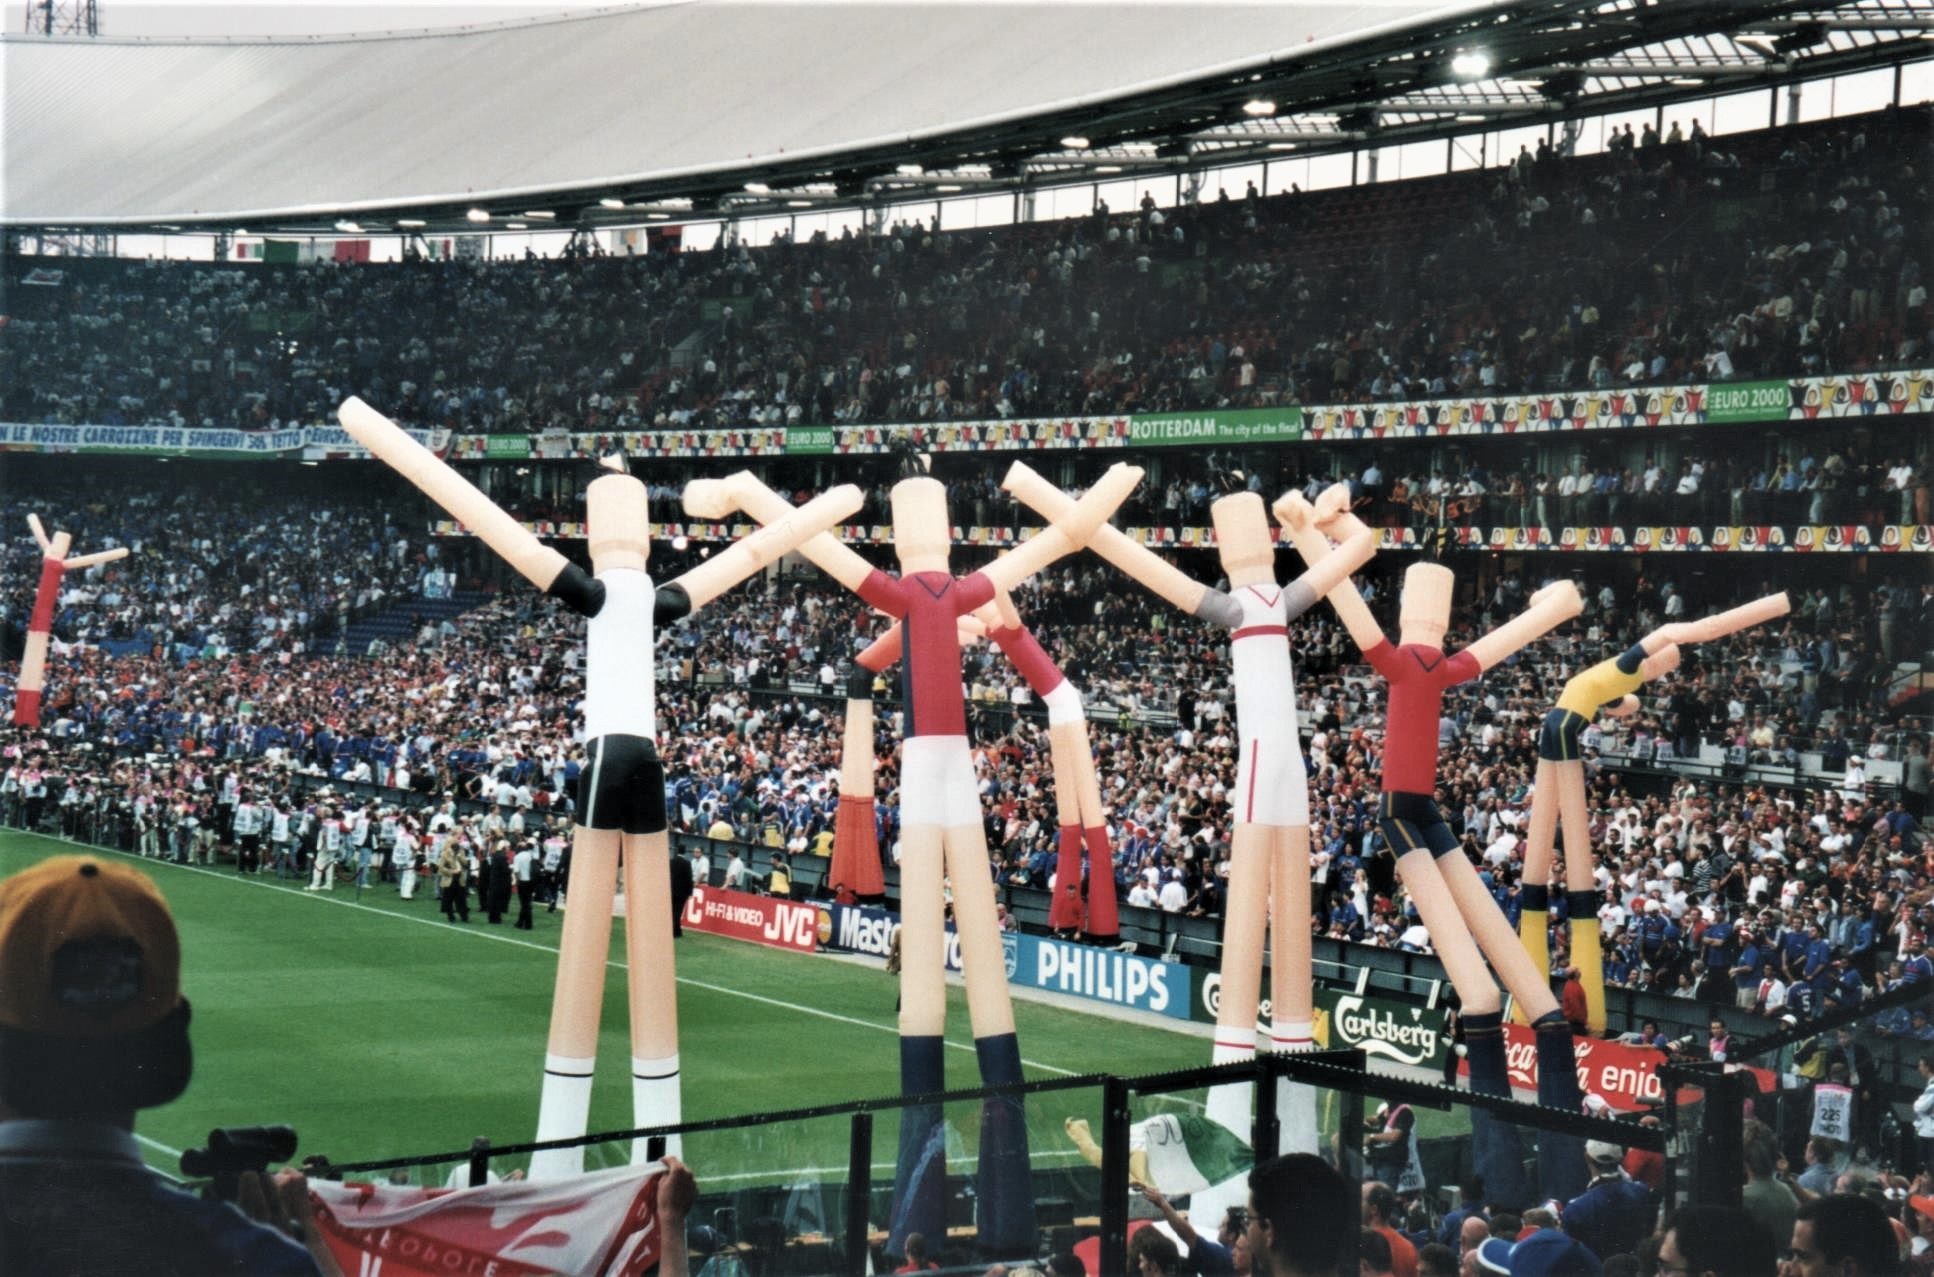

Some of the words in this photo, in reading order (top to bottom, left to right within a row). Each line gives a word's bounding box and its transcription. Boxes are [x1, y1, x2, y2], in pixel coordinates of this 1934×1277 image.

[1715, 391, 1748, 408] EURO
[1751, 388, 1784, 406] 2000
[13, 426, 27, 441] LE
[31, 426, 80, 443] NOSTRE
[83, 428, 158, 445] CARROZZINE
[162, 429, 183, 446] PER
[187, 431, 245, 448] SPINGERVI
[271, 431, 300, 447] TETTO
[1132, 419, 1216, 438] ROTTERDAM
[1219, 425, 1234, 434] The
[1235, 423, 1250, 438] city
[1252, 424, 1262, 433] of
[1263, 422, 1276, 433] the
[1278, 421, 1299, 433] final
[764, 903, 815, 947] JVC
[1037, 940, 1169, 1011] PHILIPS
[1334, 994, 1438, 1059] Carlsberg
[1820, 1107, 1841, 1121] 225
